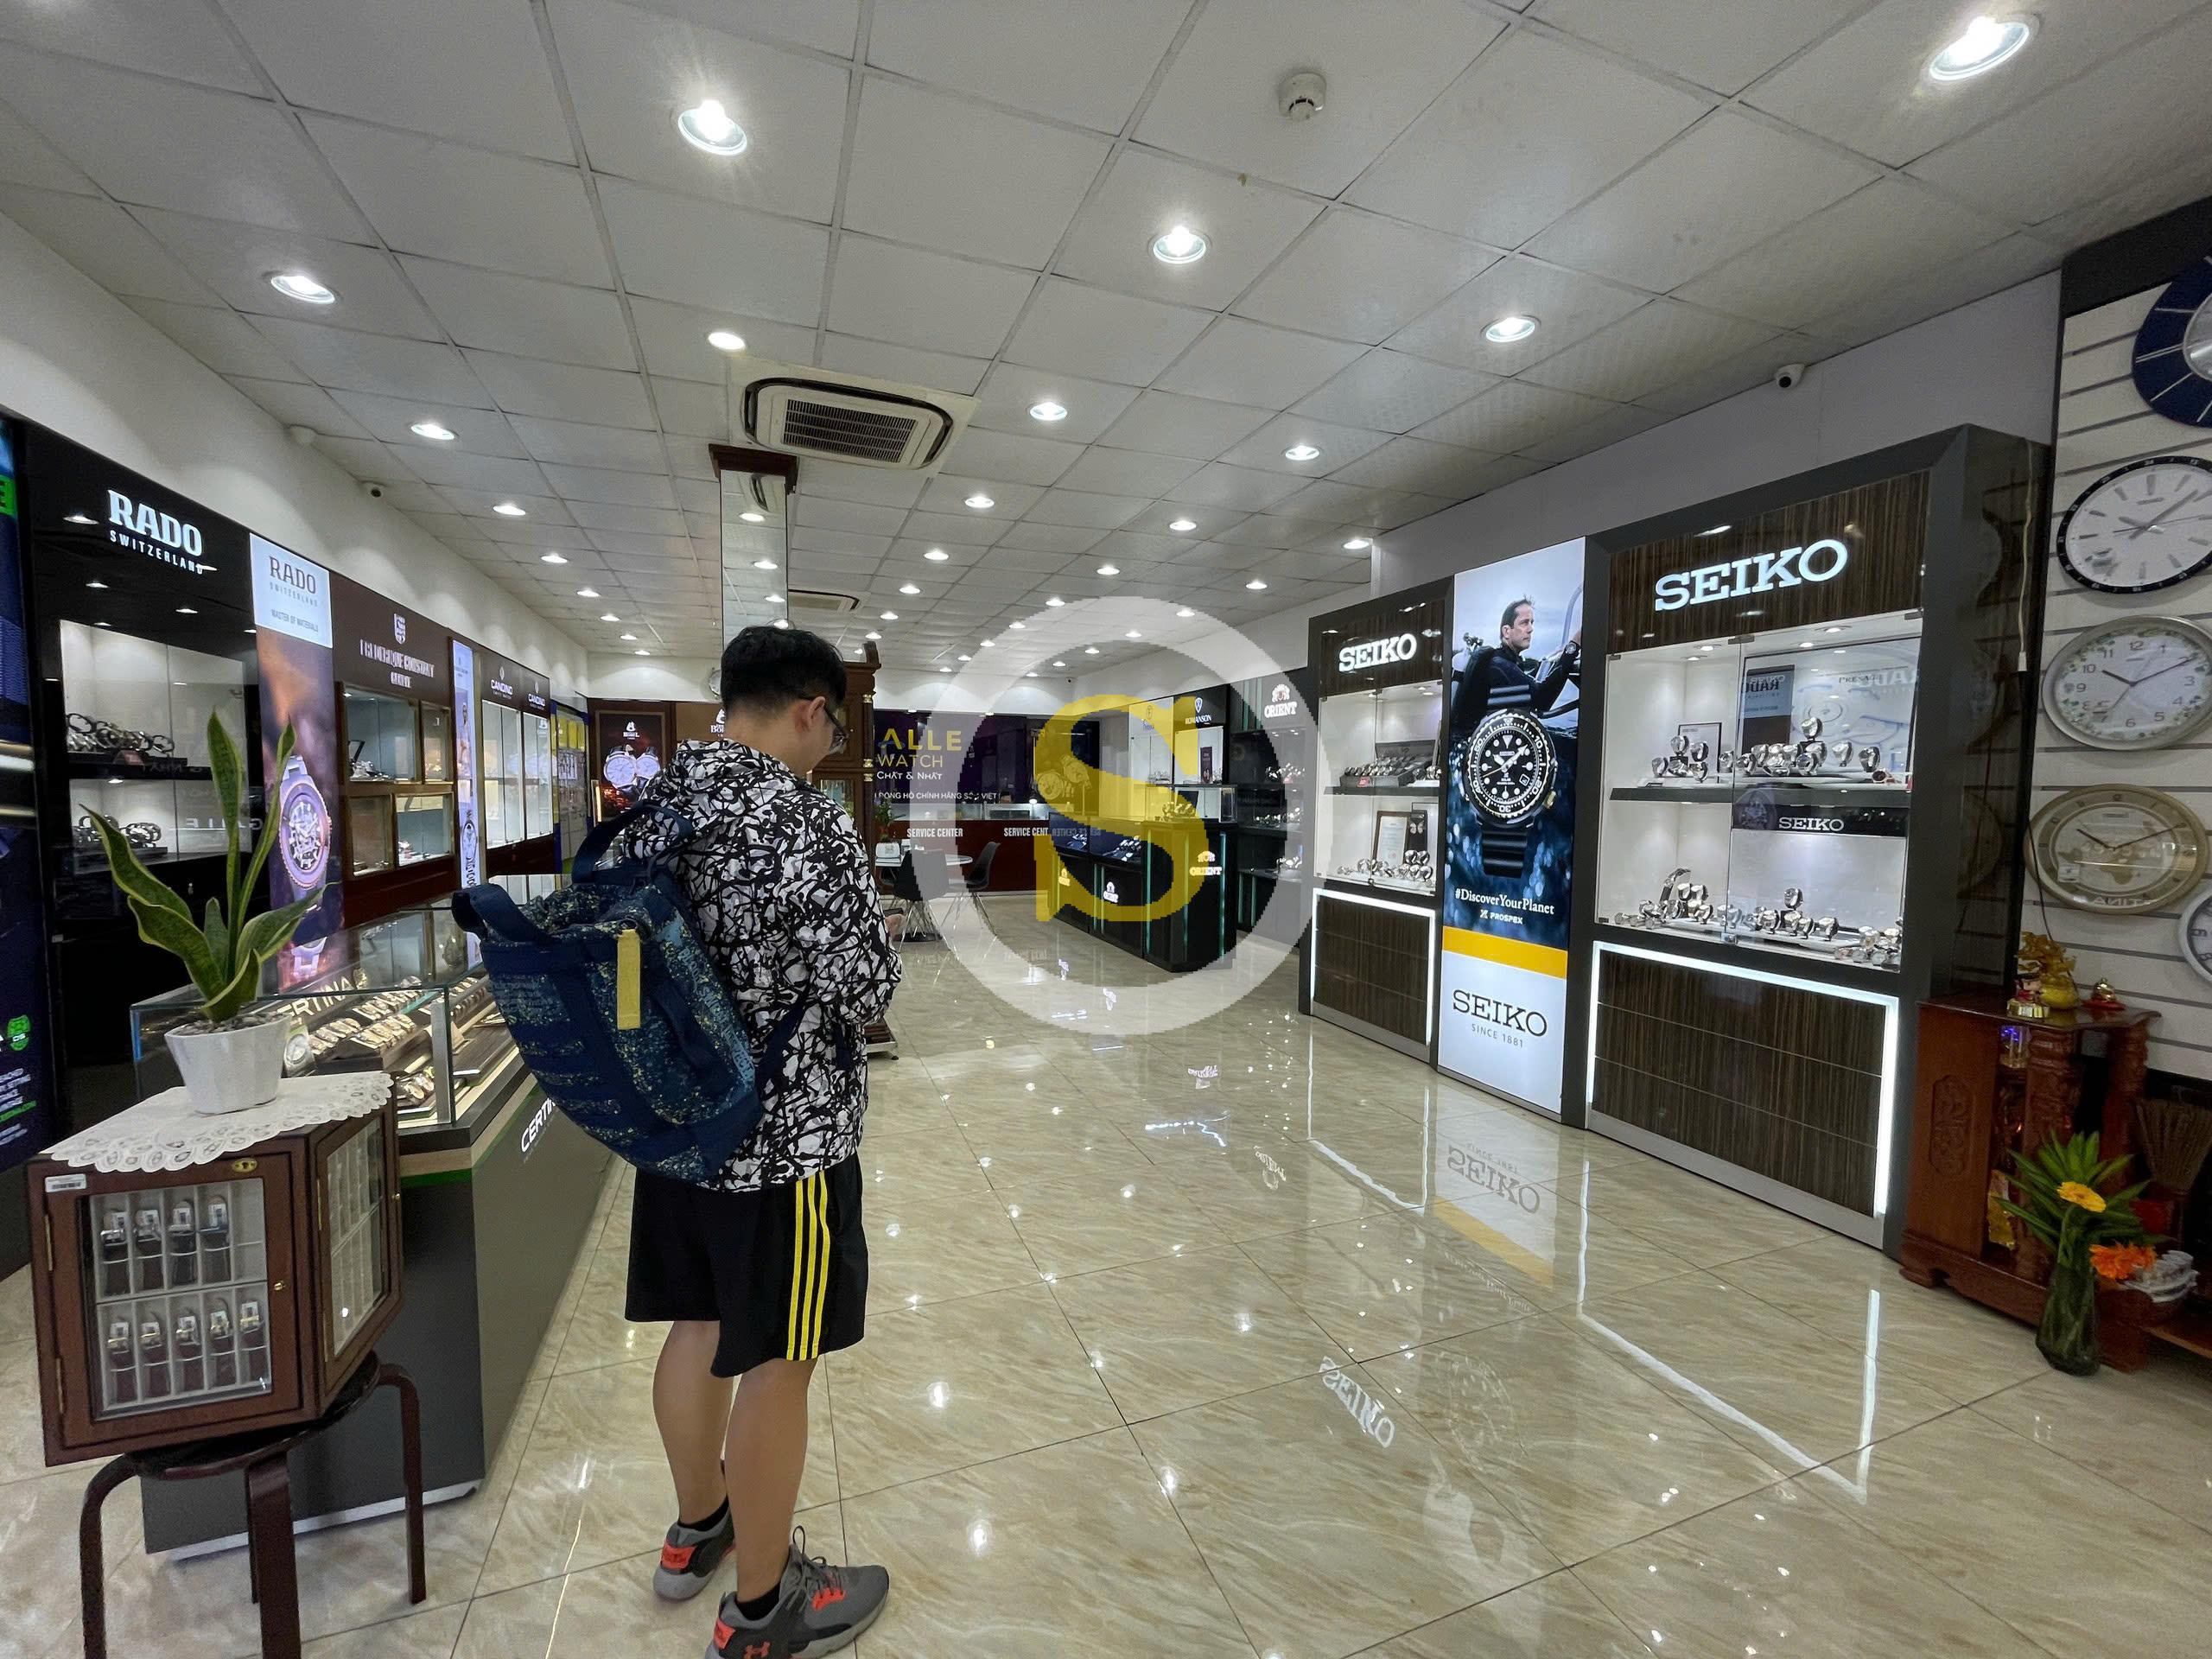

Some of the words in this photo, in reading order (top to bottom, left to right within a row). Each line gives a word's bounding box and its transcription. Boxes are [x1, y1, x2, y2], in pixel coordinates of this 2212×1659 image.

[107, 489, 203, 557] RADO
[110, 530, 204, 575] SWITZERLAND
[269, 556, 316, 594] RADO
[1654, 538, 1848, 612] SEIKO
[1338, 632, 1418, 672] SEIKO
[2129, 640, 2145, 652] 12
[2082, 664, 2097, 673] 10
[2076, 683, 2087, 693] 9
[2184, 676, 2196, 686] 3
[2172, 696, 2183, 705] 4
[1264, 702, 1297, 718] ORIENT
[2154, 712, 2164, 721] 5
[2126, 718, 2136, 728] 6
[884, 728, 963, 751] ALLE
[1535, 735, 1543, 749] 10
[877, 754, 944, 768] WATCH
[906, 771, 913, 779] &
[1778, 817, 1845, 832] SEIKO
[907, 828, 935, 837] SERVICE
[937, 828, 963, 837] CENTER
[1003, 827, 1031, 837] SERVICE
[1454, 888, 1554, 915] #DiscoverYourPlanet
[1490, 912, 1522, 925] PROSPEX
[1452, 988, 1548, 1038] SEIKO
[1471, 1023, 1497, 1039] SINCE
[1503, 1033, 1522, 1048] 1881
